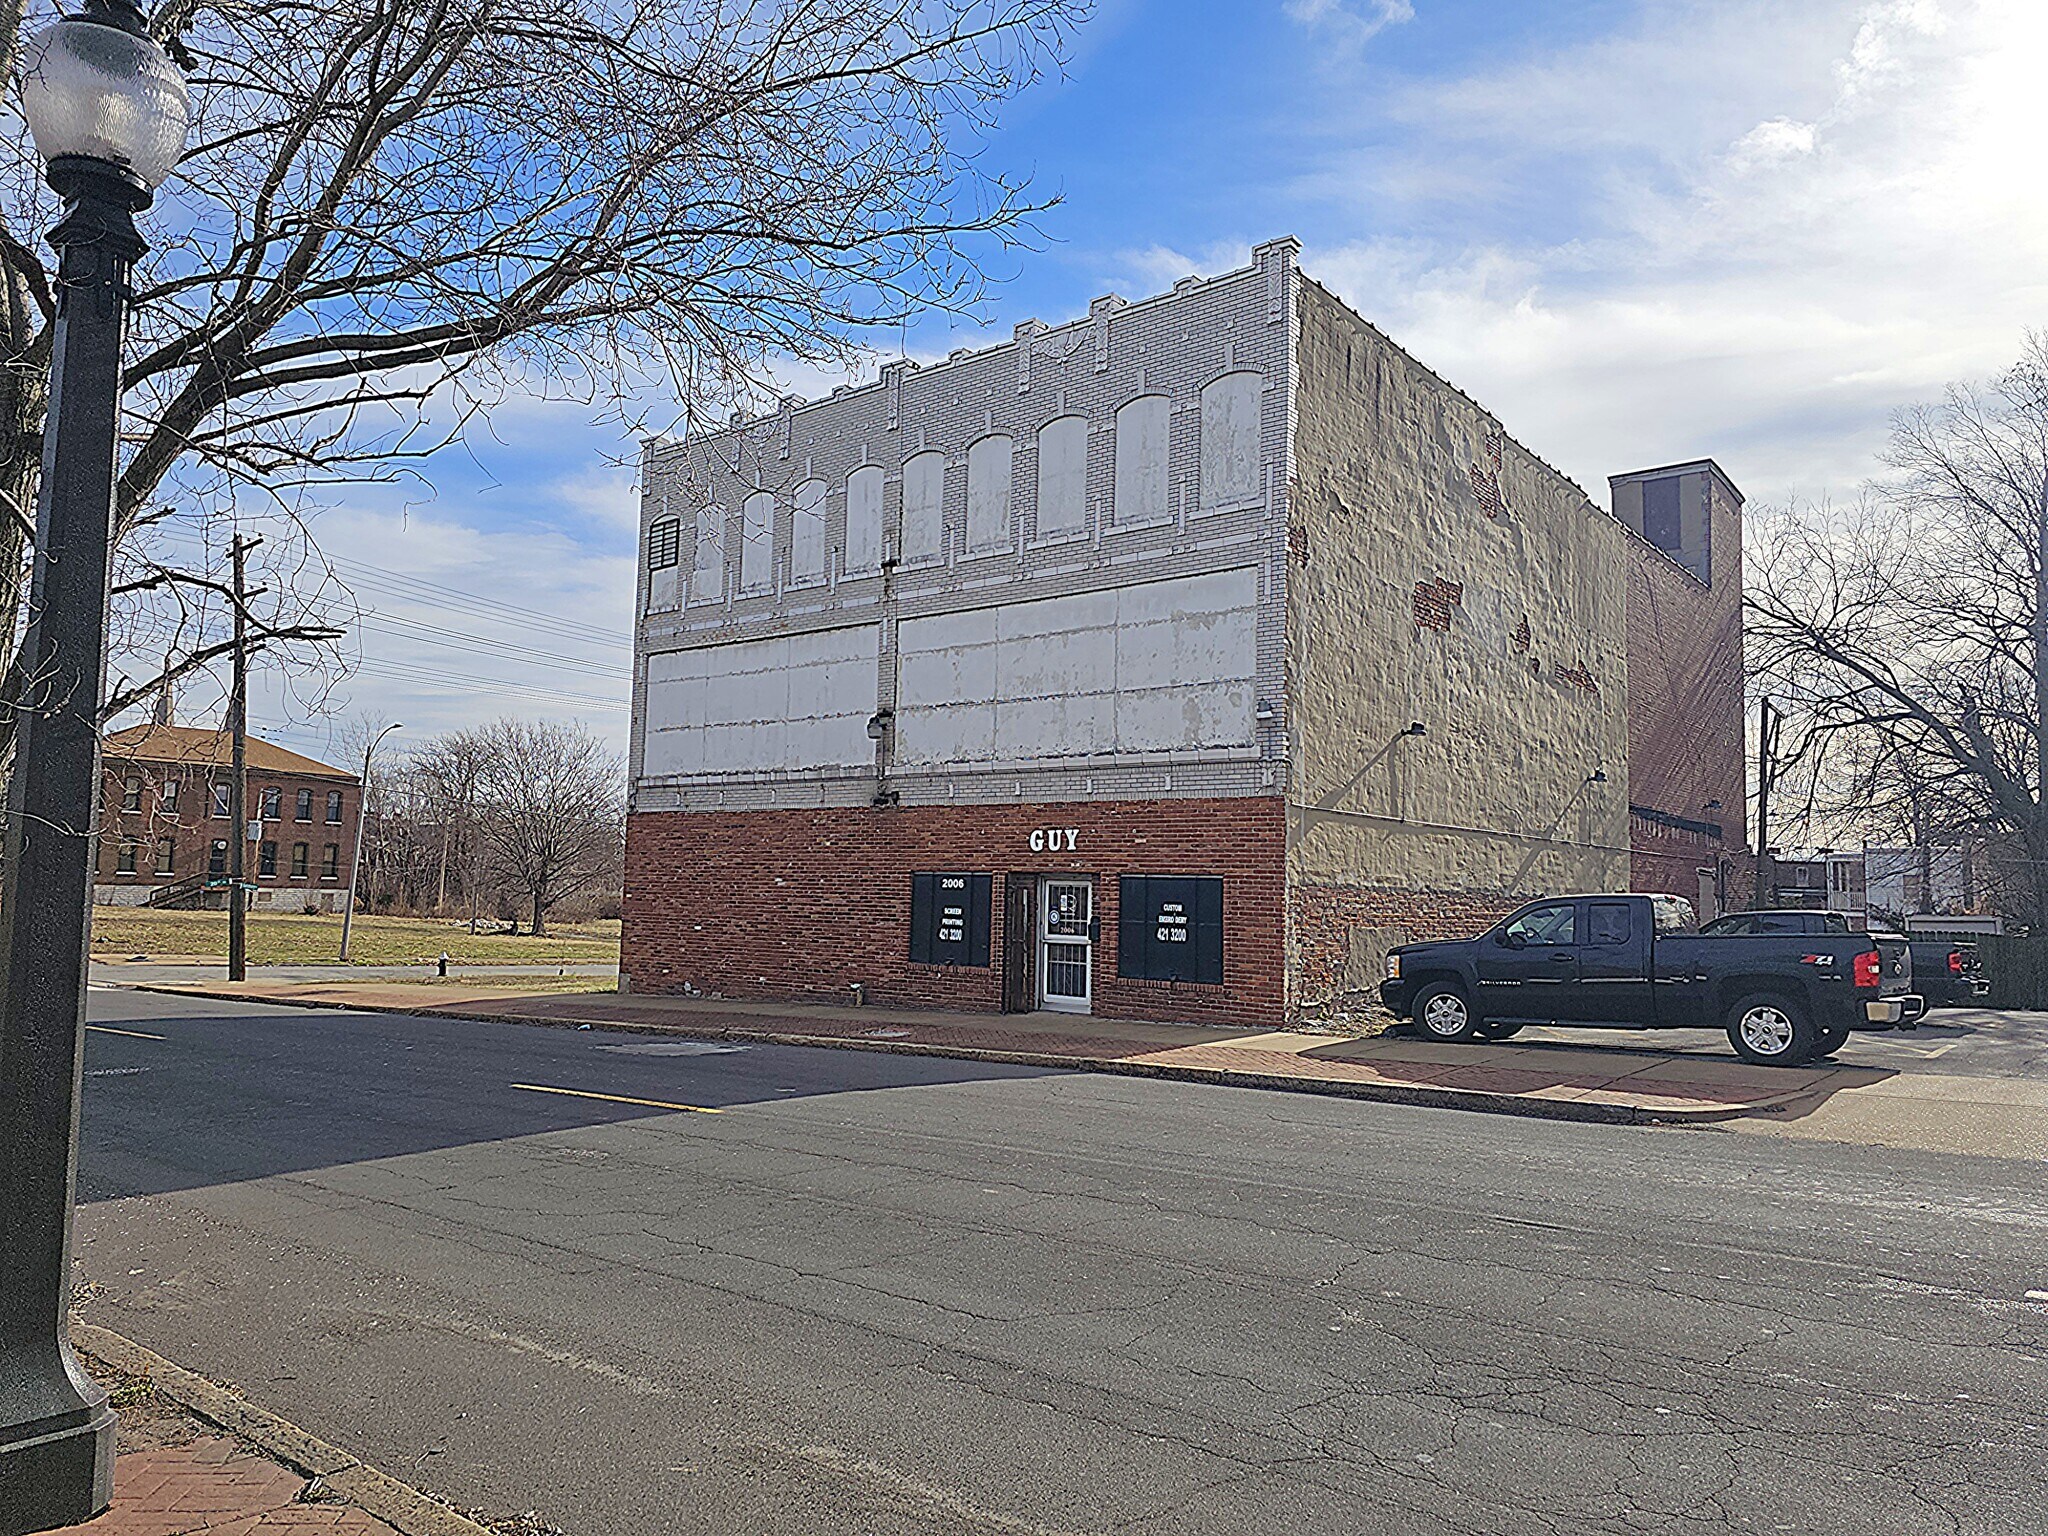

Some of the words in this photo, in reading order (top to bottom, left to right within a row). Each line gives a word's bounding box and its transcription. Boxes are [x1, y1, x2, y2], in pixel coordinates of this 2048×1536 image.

[1030, 829, 1080, 851] GUY
[942, 878, 964, 888] 2006
[944, 907, 962, 915] SCREEN
[1163, 903, 1182, 912] CUSTOM
[942, 918, 963, 926] PRINTING
[1060, 926, 1075, 934] 2006
[1157, 927, 1169, 941] 421
[1170, 928, 1187, 942] 3200
